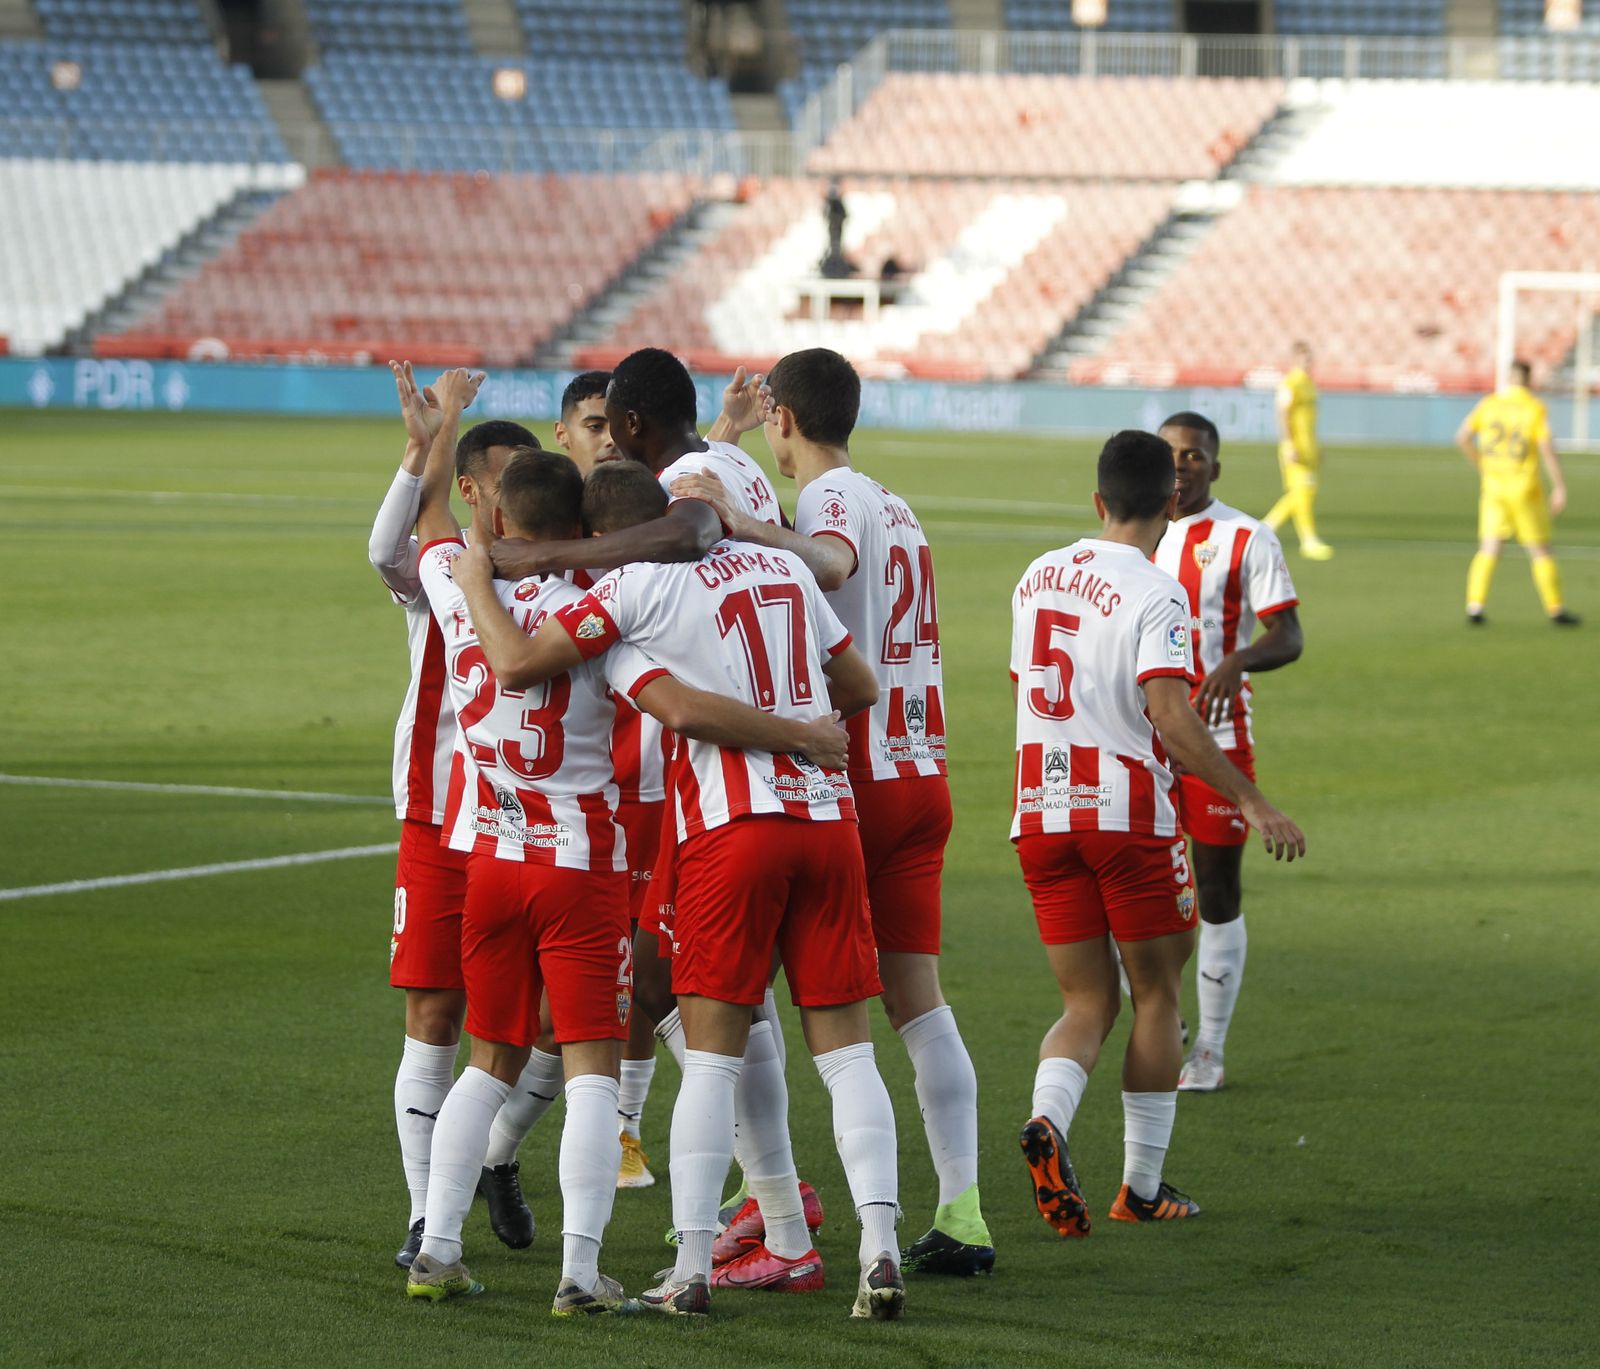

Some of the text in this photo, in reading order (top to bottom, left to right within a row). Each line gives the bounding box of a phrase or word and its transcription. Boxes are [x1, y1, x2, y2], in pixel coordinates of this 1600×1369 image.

[74, 359, 155, 411] PDR
[694, 552, 792, 591] CORPAS
[1020, 566, 1122, 618] MORLANES
[880, 544, 940, 665] 24
[714, 582, 813, 712] 17
[1027, 608, 1081, 722] 5
[452, 645, 572, 782] 23
[1170, 841, 1189, 885] 5
[616, 936, 634, 987] 2
